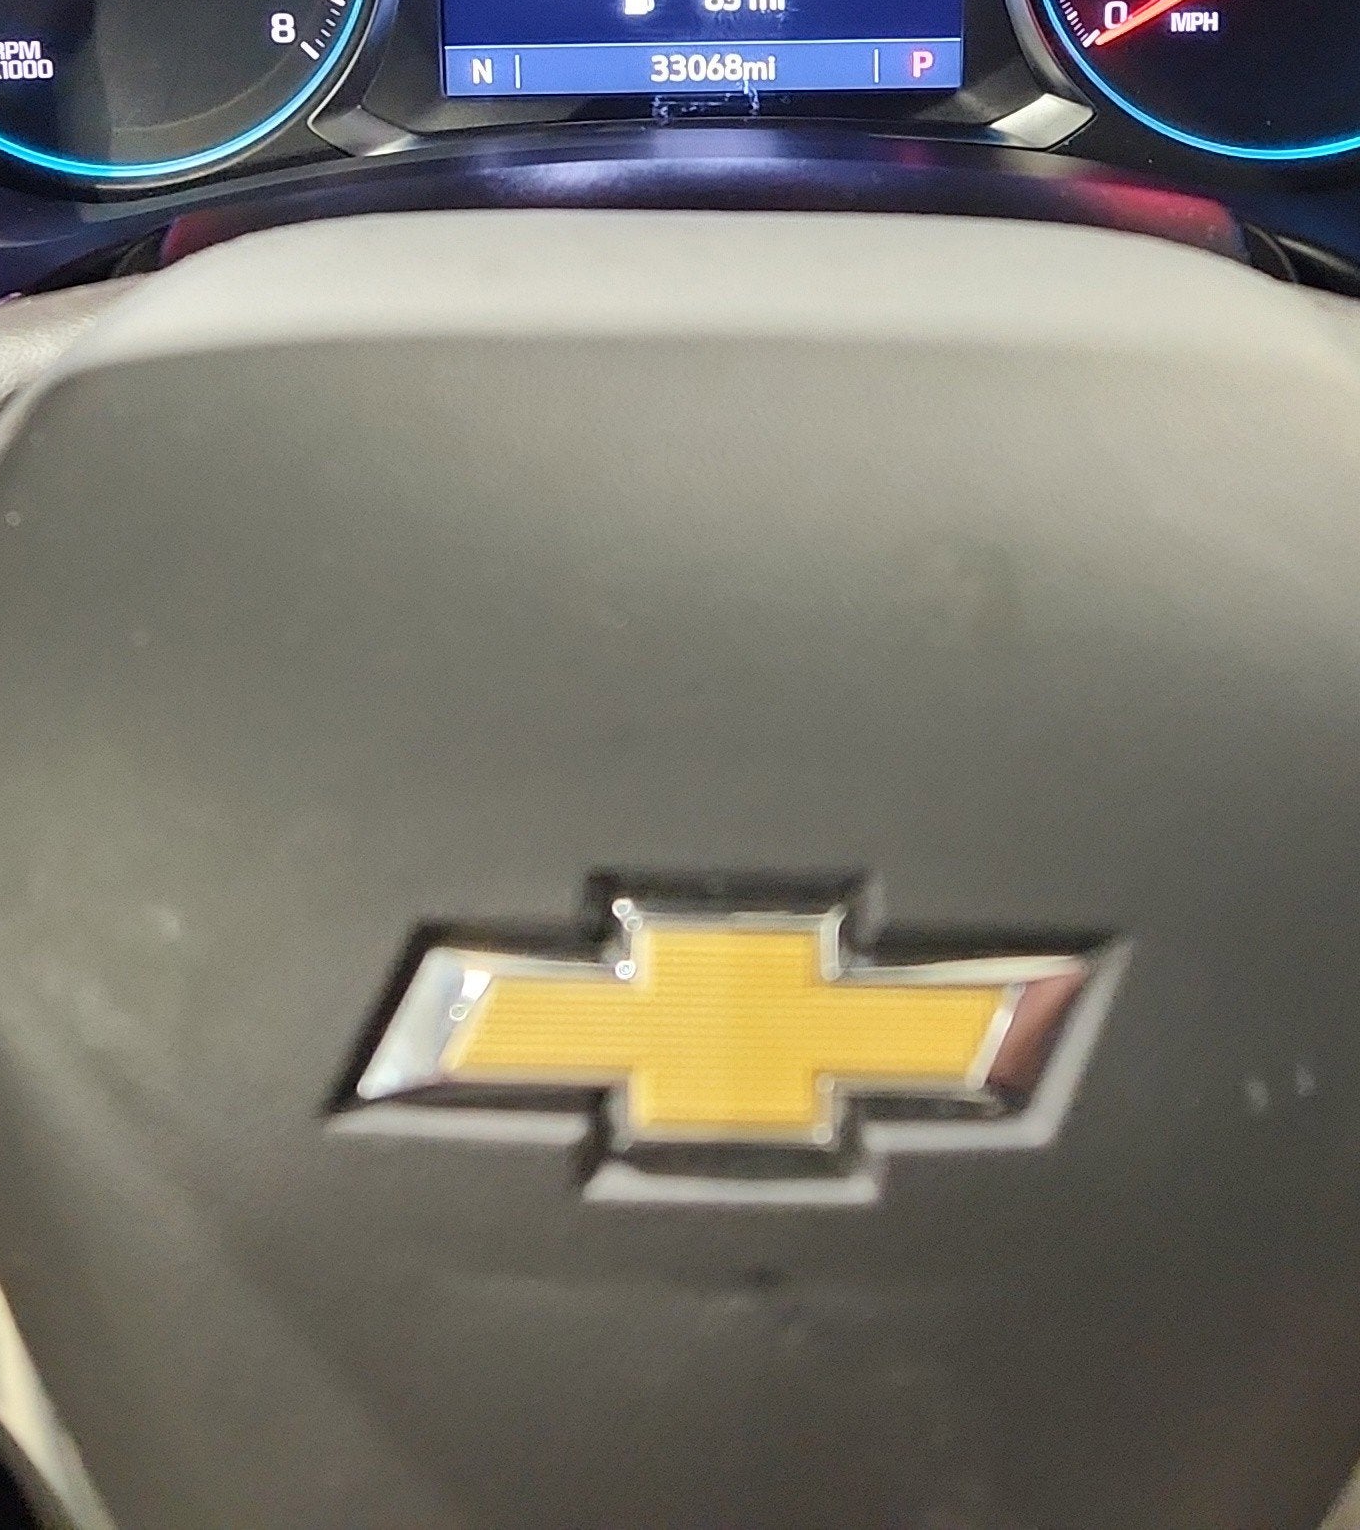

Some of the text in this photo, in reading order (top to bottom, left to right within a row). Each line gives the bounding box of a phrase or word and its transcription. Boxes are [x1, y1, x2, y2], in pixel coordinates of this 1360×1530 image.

[270, 12, 296, 44] 8
[1104, 0, 1128, 30] 0
[1170, 11, 1219, 32] MPH
[472, 58, 493, 84] N
[912, 51, 934, 78] P
